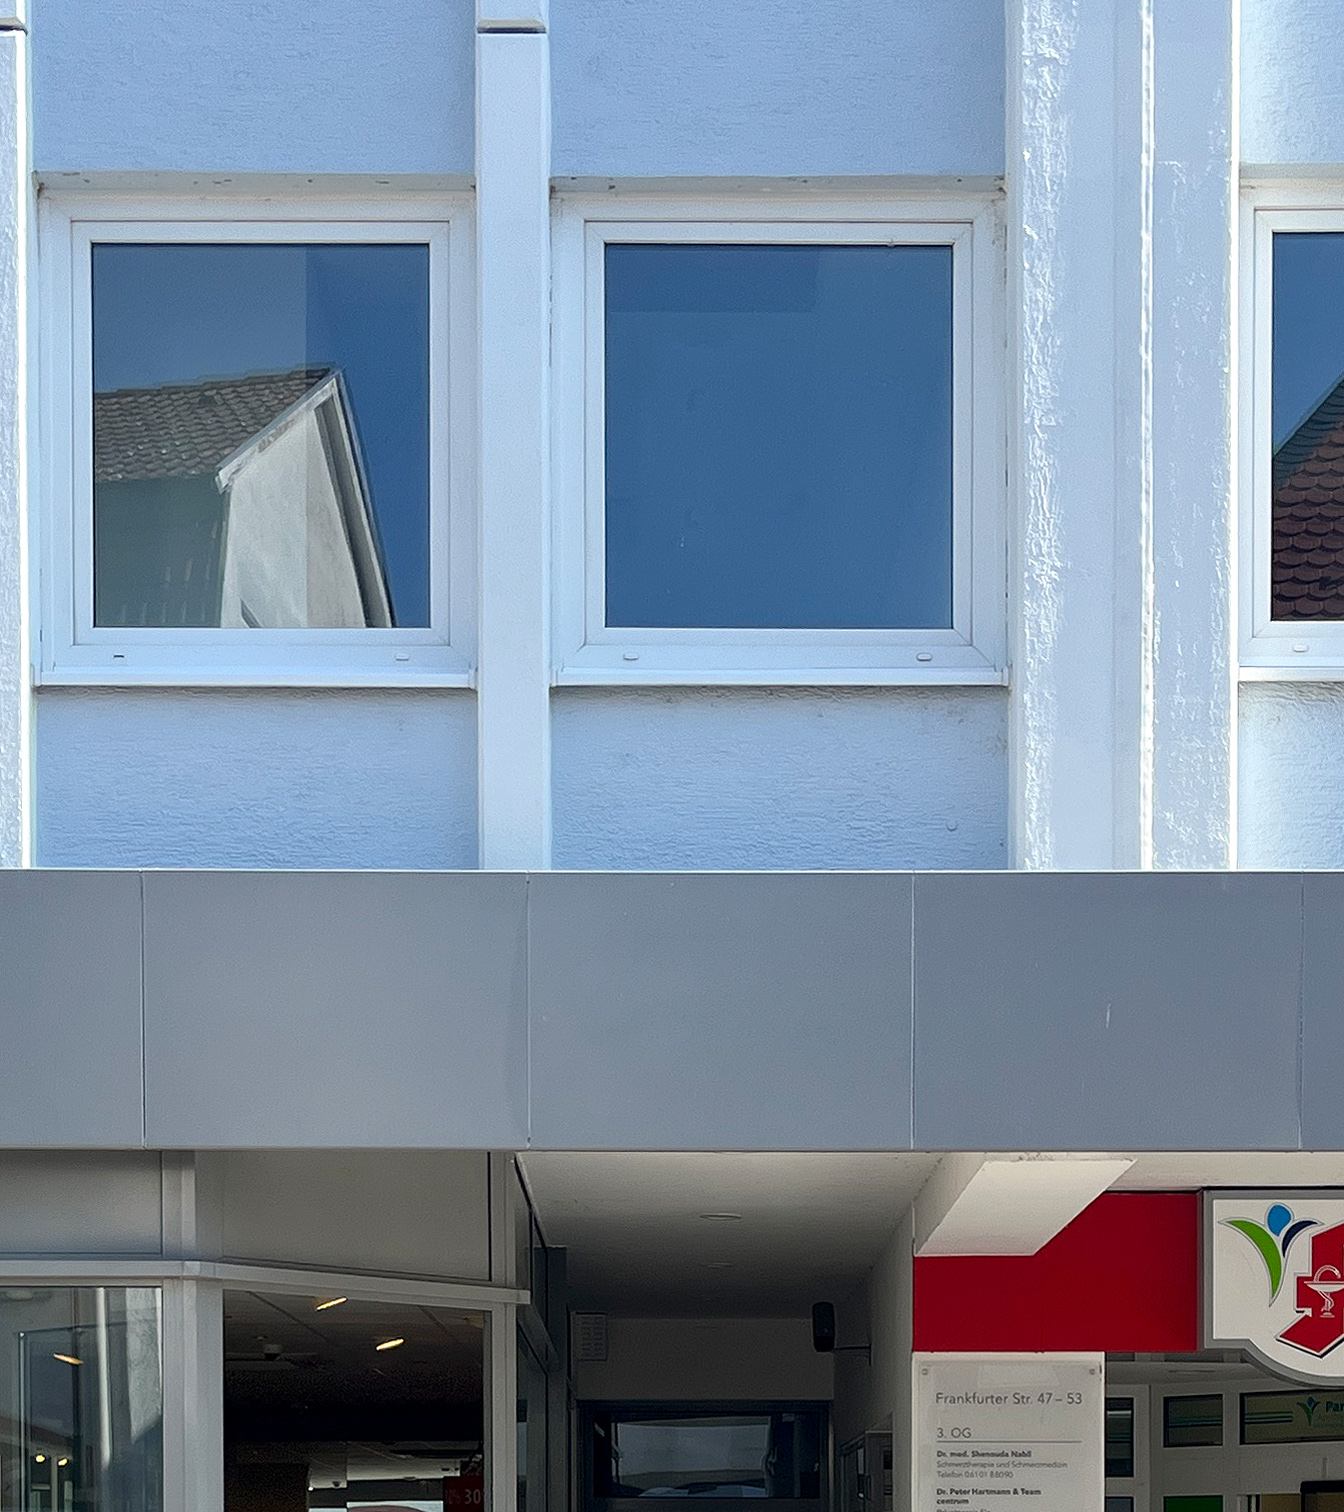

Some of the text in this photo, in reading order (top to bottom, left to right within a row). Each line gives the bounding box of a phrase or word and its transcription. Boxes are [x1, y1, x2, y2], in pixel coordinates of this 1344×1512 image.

[936, 1392, 1008, 1405] Frankfurter
[1012, 1392, 1033, 1405] Str.
[1037, 1392, 1053, 1405] 47
[1067, 1392, 1082, 1405] 53
[937, 1428, 972, 1438] 3. OG
[936, 1488, 948, 1496] Dr.
[950, 1488, 970, 1496] Peter
[972, 1488, 1010, 1496] Hartmann
[1020, 1488, 1041, 1496] Team
